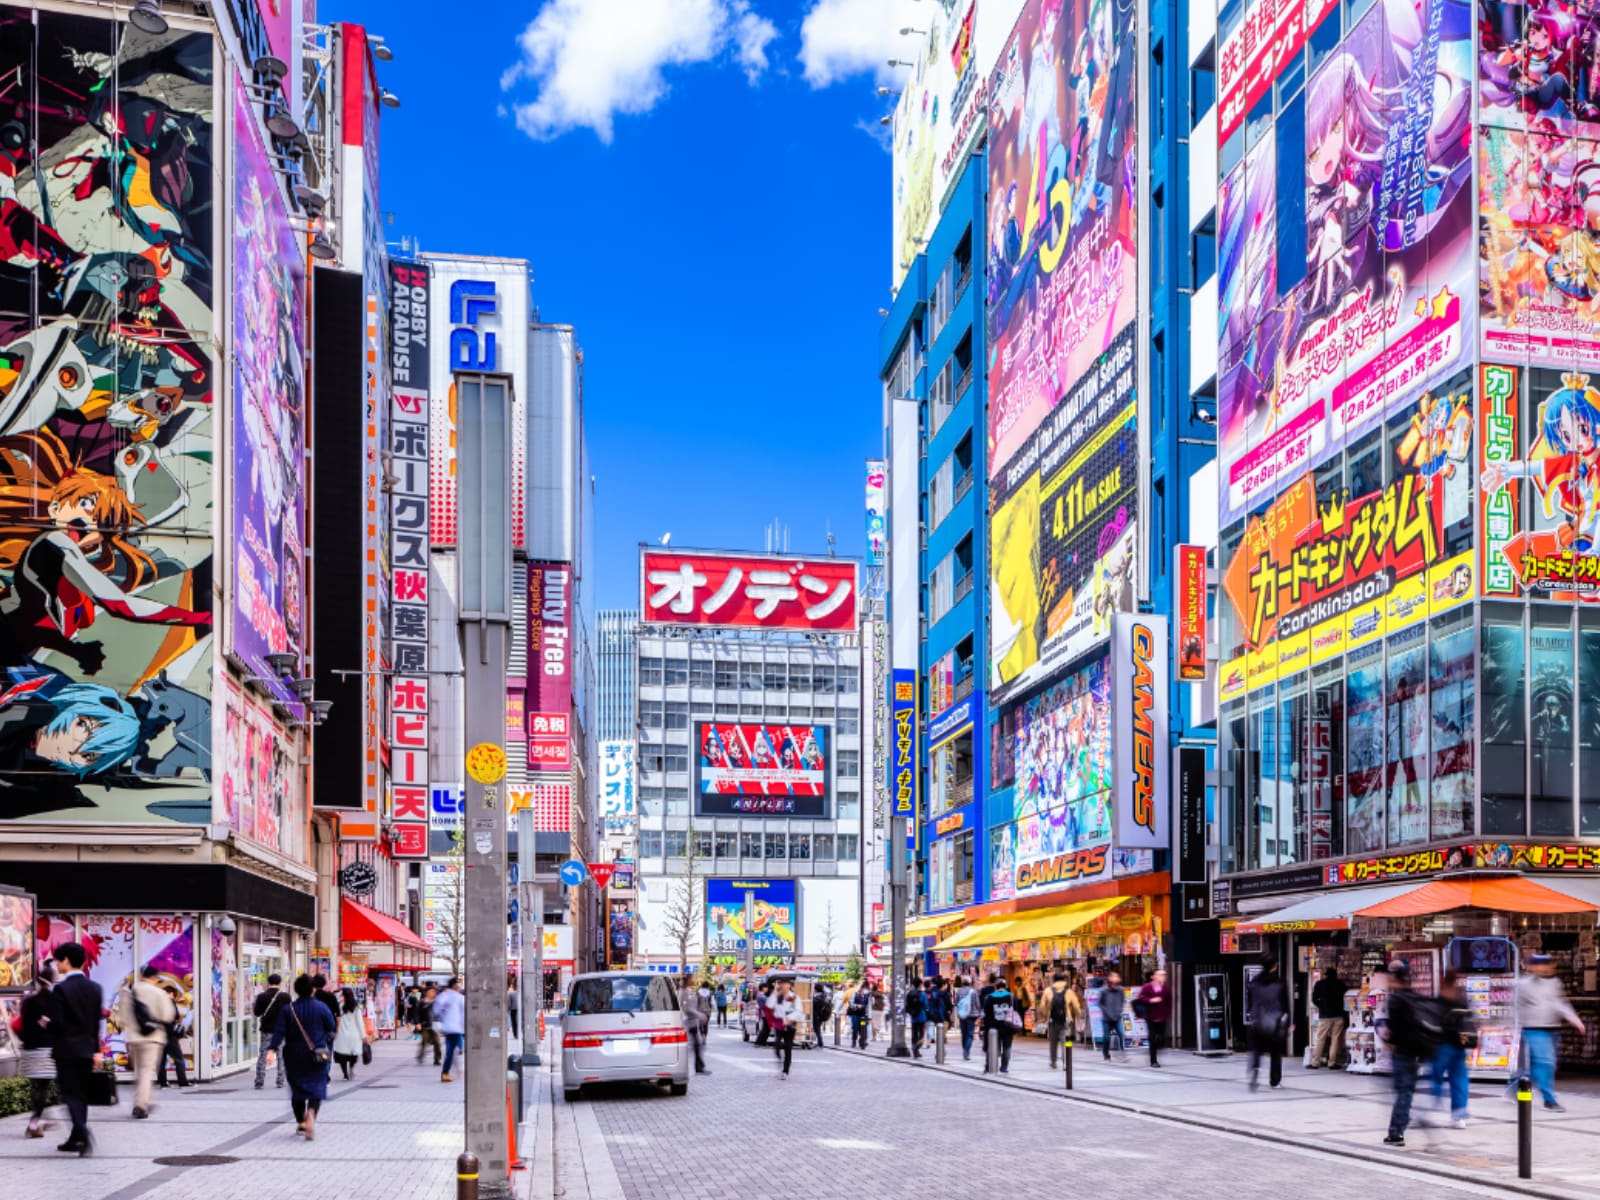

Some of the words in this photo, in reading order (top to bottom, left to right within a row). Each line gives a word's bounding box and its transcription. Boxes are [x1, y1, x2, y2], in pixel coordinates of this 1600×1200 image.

[393, 266, 410, 383] PARADISE
[411, 269, 426, 348] HOBBY
[1052, 475, 1084, 541] 4.11
[1098, 465, 1121, 505] SALE
[1250, 473, 1438, 643] カードキングダム
[1519, 551, 1600, 584] カードキングダ
[544, 570, 569, 622] Duty
[648, 562, 852, 620] オノデン
[544, 626, 569, 676] Free
[534, 716, 565, 732] 免税
[1132, 623, 1155, 834] GAMERS
[732, 798, 795, 812] ANIPLEX
[1016, 845, 1110, 890] GAMERS
[709, 938, 790, 951] AKIBARA
